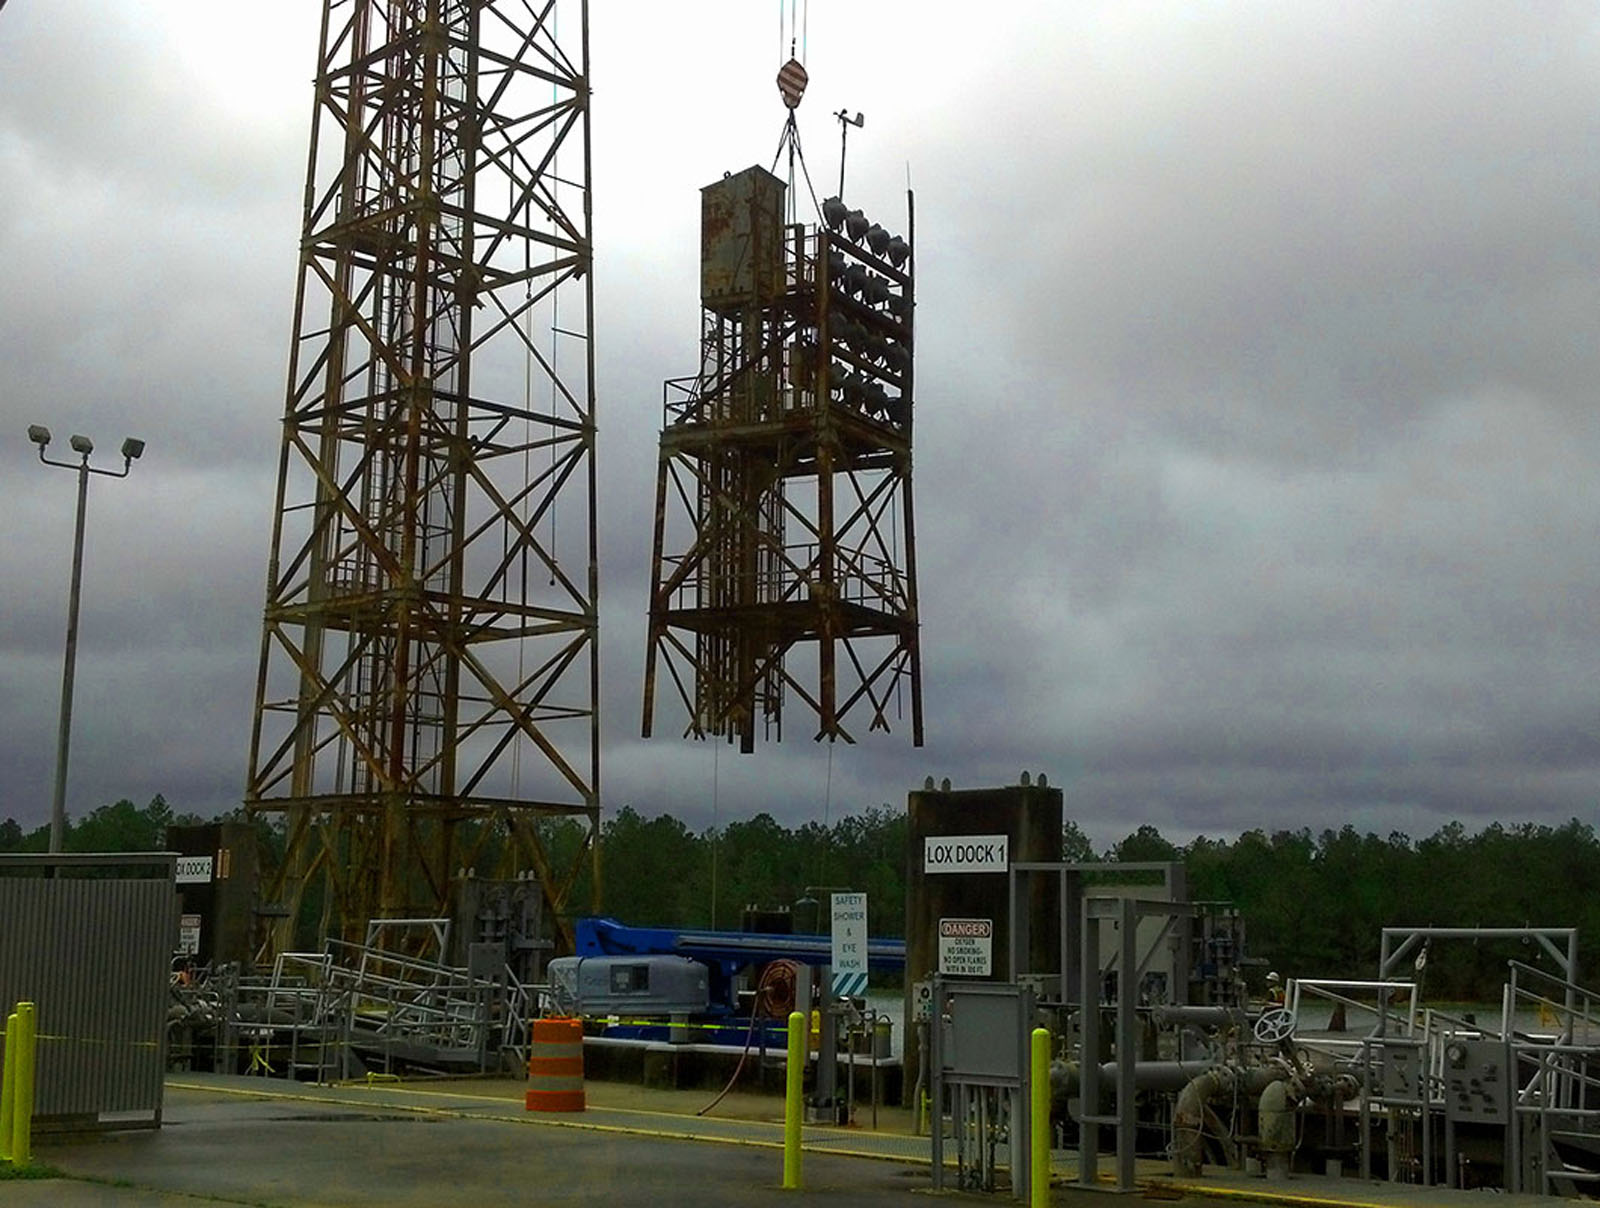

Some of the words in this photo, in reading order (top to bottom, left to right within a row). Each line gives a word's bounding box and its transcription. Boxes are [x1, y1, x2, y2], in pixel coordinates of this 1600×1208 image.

[927, 845, 953, 863] LOX
[956, 844, 994, 863] DOCK
[998, 844, 1005, 862] 1
[186, 862, 205, 875] DOCK
[834, 896, 863, 905] SAFETY
[833, 911, 865, 921] SHOWER
[846, 927, 852, 937] &
[945, 923, 985, 936] DANGER
[842, 943, 857, 953] EYE
[839, 959, 860, 969] WASH
[943, 955, 951, 964] NO
[953, 956, 966, 964] OPEN
